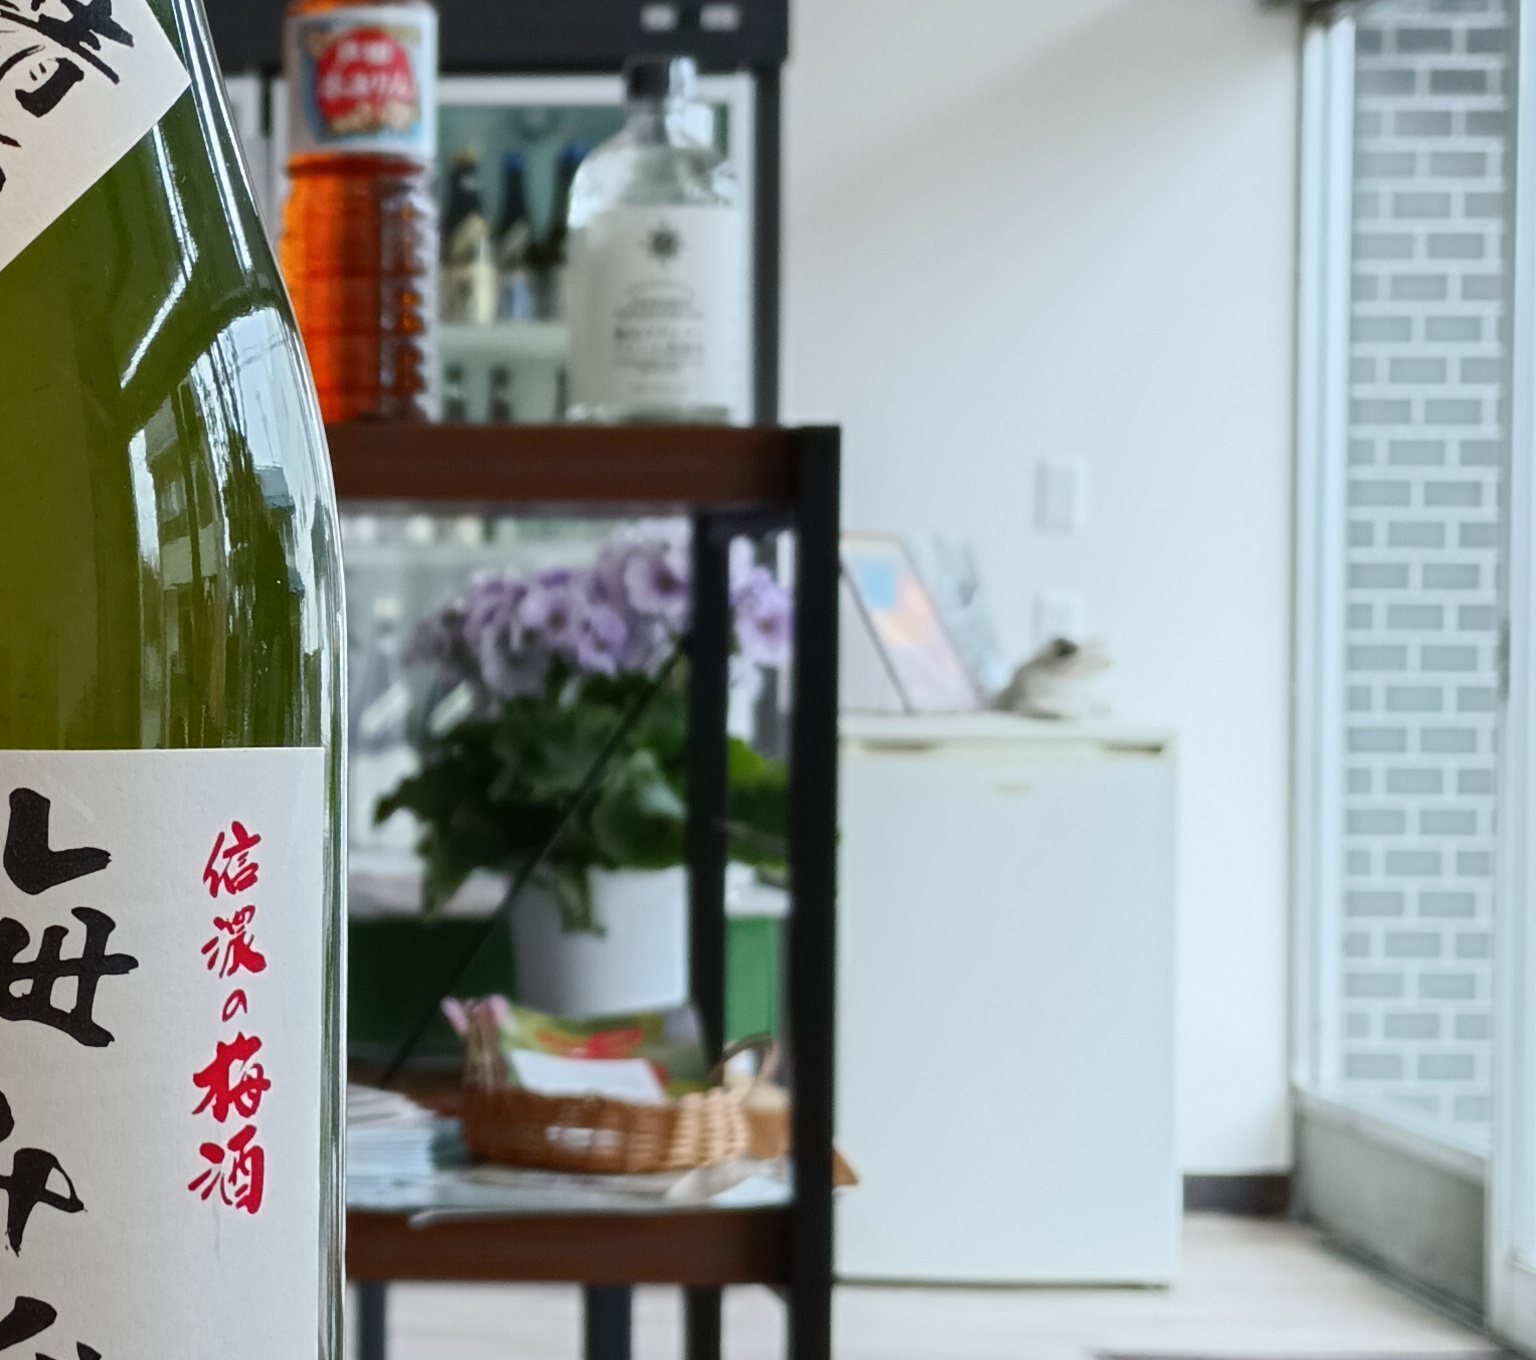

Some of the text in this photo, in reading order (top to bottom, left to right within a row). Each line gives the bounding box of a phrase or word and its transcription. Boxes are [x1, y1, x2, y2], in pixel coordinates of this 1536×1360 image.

[187, 819, 272, 1215] 信濃の梅酒
